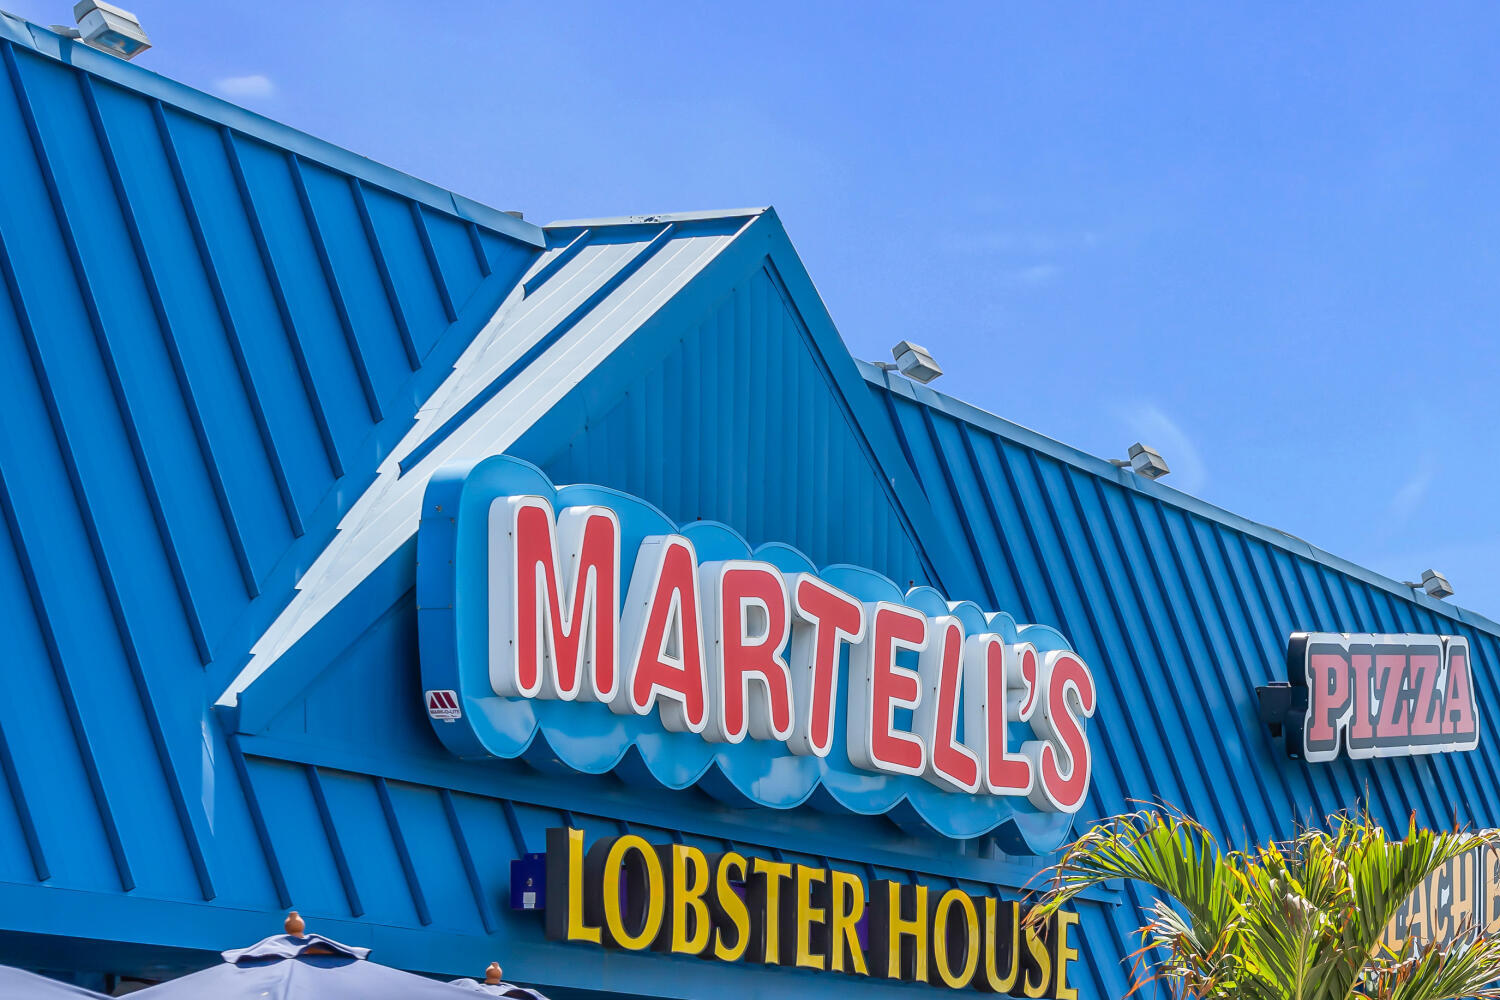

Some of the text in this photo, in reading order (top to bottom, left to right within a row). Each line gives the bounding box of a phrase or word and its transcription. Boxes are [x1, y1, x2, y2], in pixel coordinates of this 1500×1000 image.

[500, 495, 1096, 814] MARTELL'S
[1309, 653, 1475, 742] PIZZA
[567, 827, 869, 976] LOBSTER
